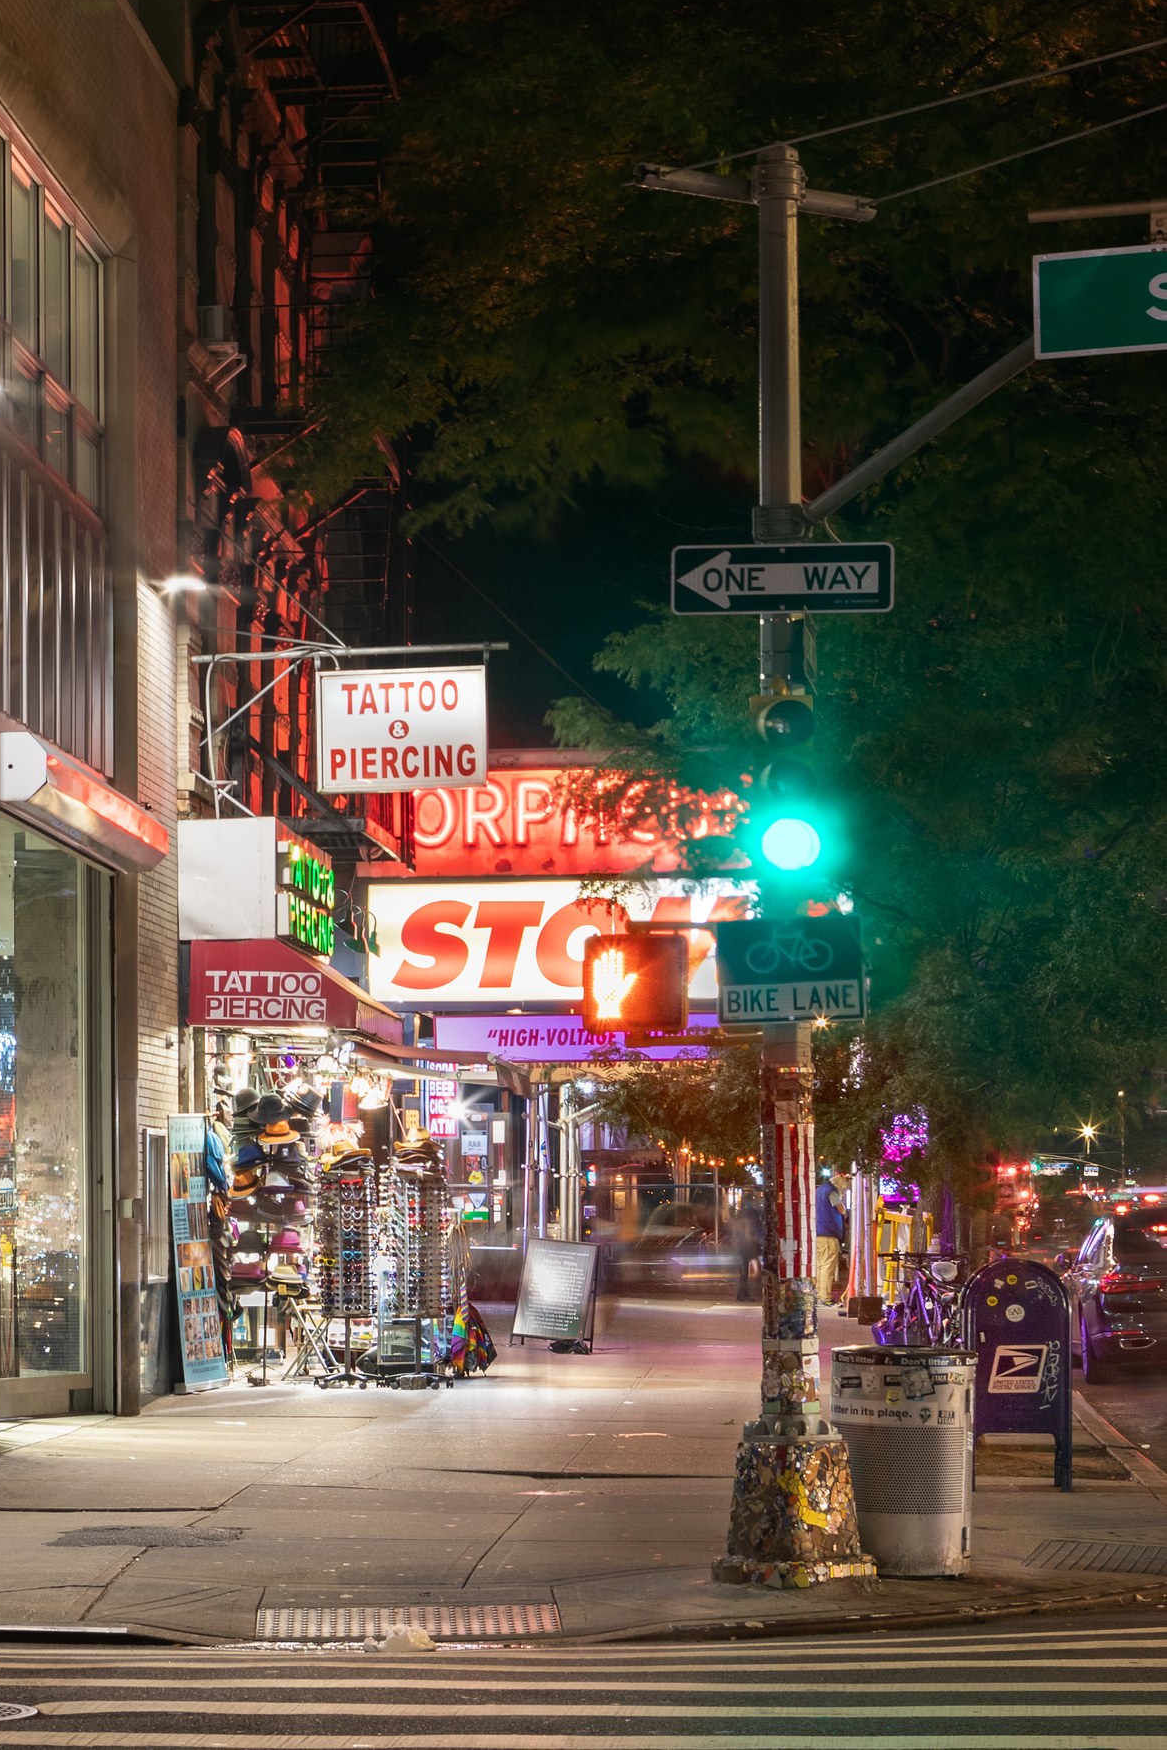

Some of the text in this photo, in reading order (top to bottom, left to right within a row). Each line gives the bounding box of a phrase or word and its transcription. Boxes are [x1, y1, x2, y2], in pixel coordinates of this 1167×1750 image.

[702, 564, 872, 593] ONE WAY
[340, 678, 459, 715] TATTOO
[390, 720, 407, 739] &
[332, 742, 477, 781] PIERCING
[205, 970, 321, 995] TATTOO
[727, 984, 856, 1013] BIKE LANE
[206, 997, 326, 1021] PIERCING
[429, 1081, 455, 1097] BEER
[430, 1118, 456, 1135] ATM
[1007, 1307, 1023, 1317] SAS
[855, 1355, 875, 1364] litter
[901, 1357, 950, 1366] Don't litter
[850, 1407, 859, 1415] in
[861, 1408, 875, 1417] its
